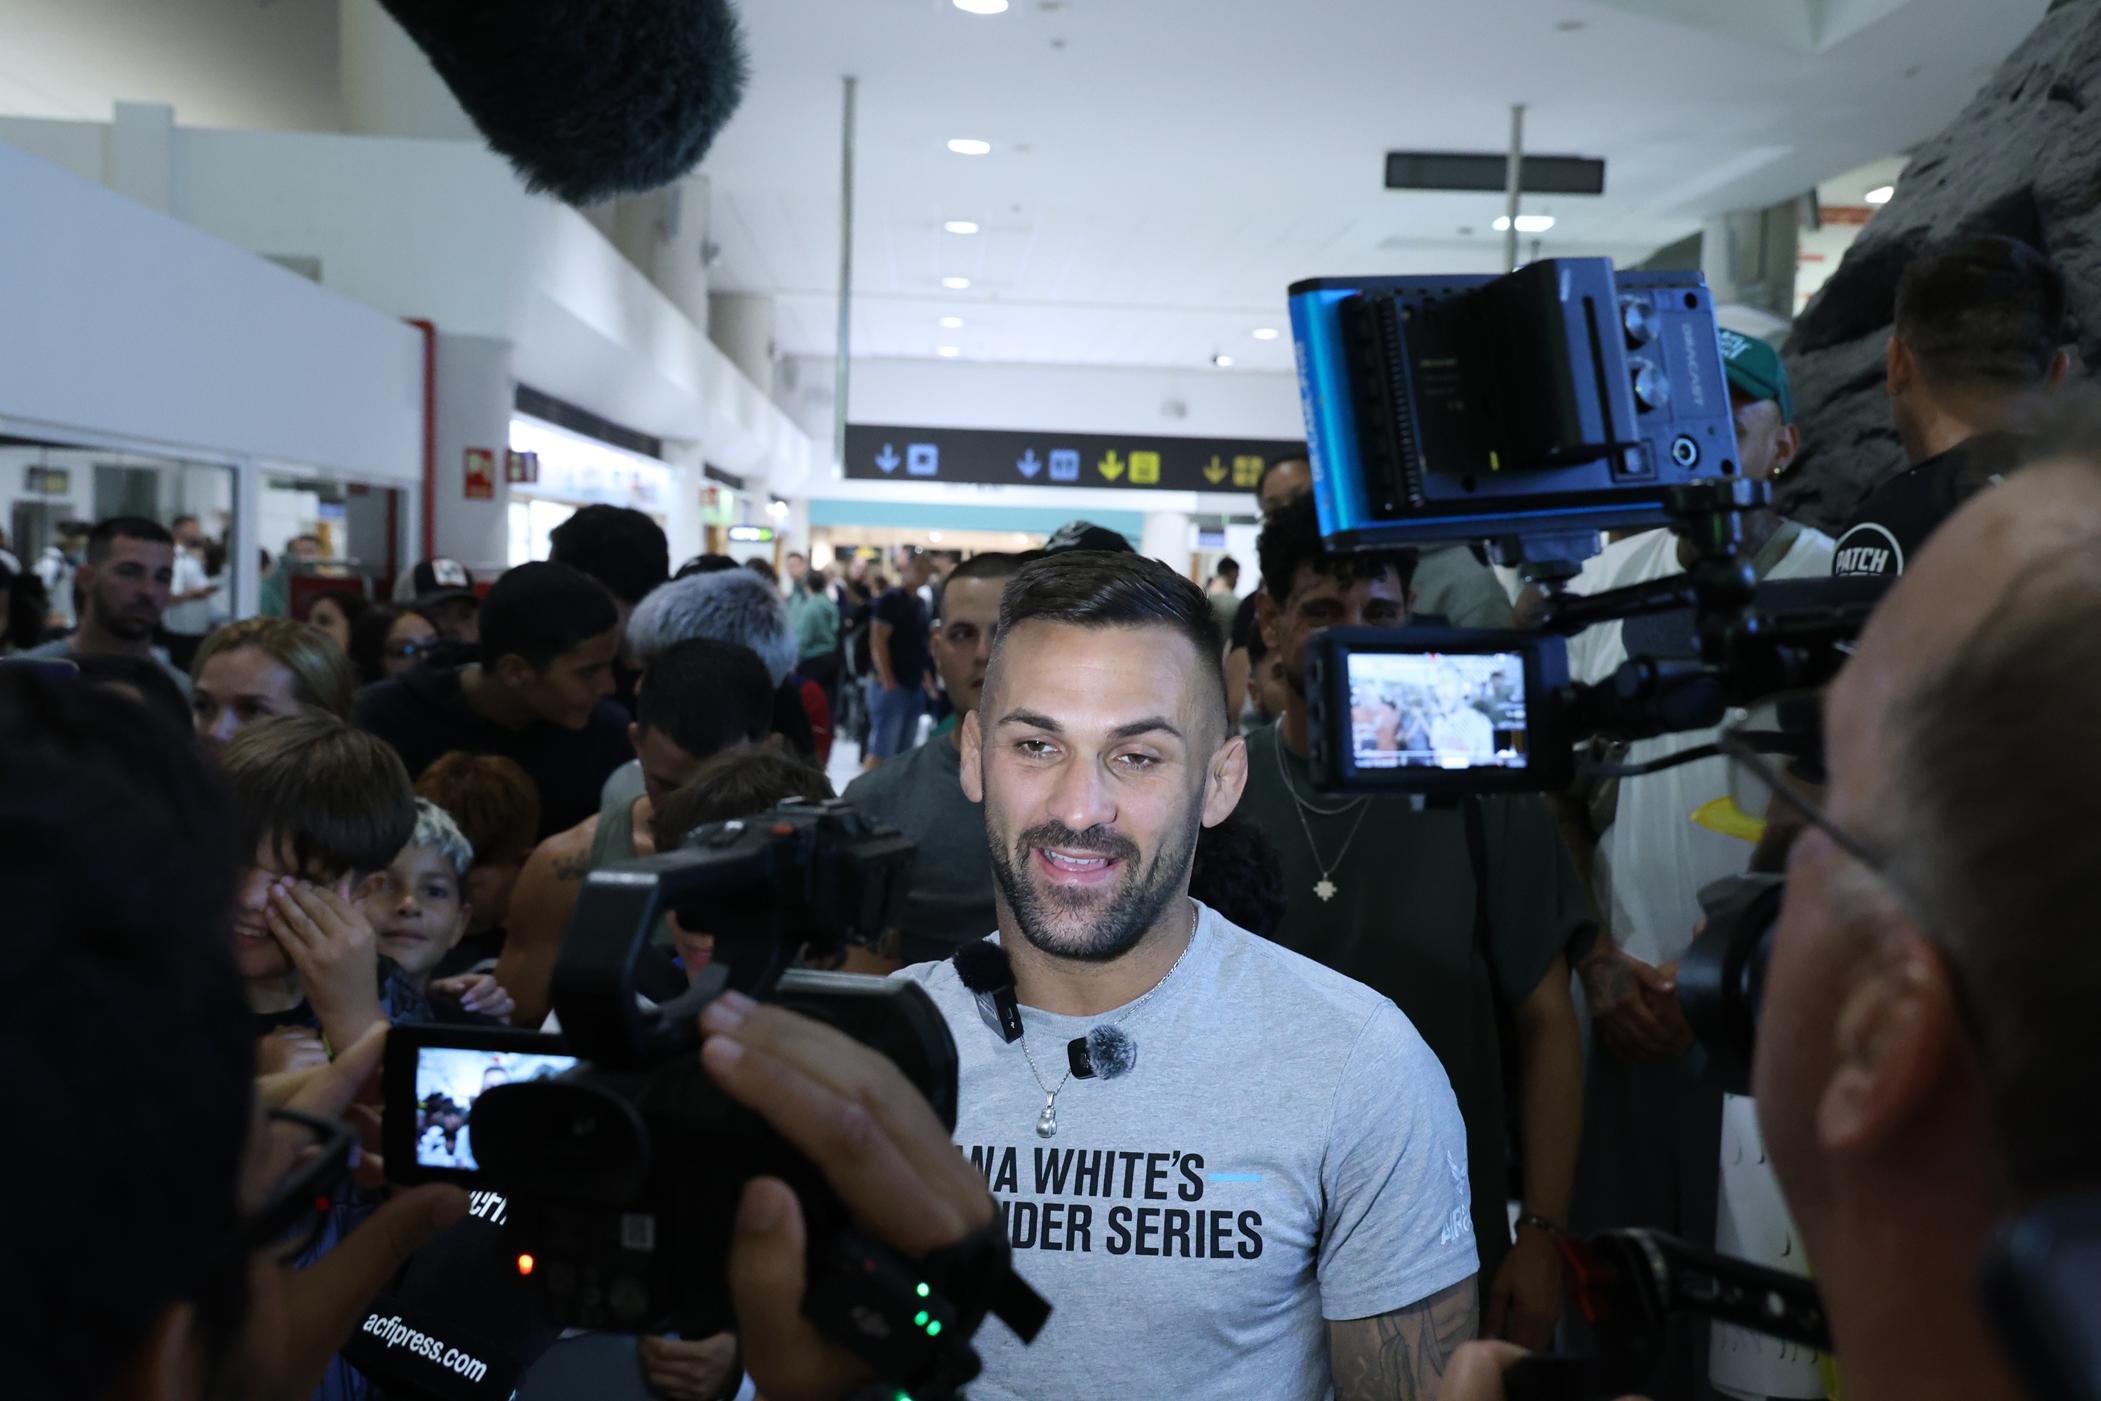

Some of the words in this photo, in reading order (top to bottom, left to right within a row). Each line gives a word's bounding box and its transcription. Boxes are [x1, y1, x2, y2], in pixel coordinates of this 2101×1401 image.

[956, 1145, 1019, 1194] NA
[1034, 1147, 1205, 1202] WHITE’S
[1106, 1205, 1264, 1260] SERIES
[362, 1313, 488, 1383] acfipress.com
